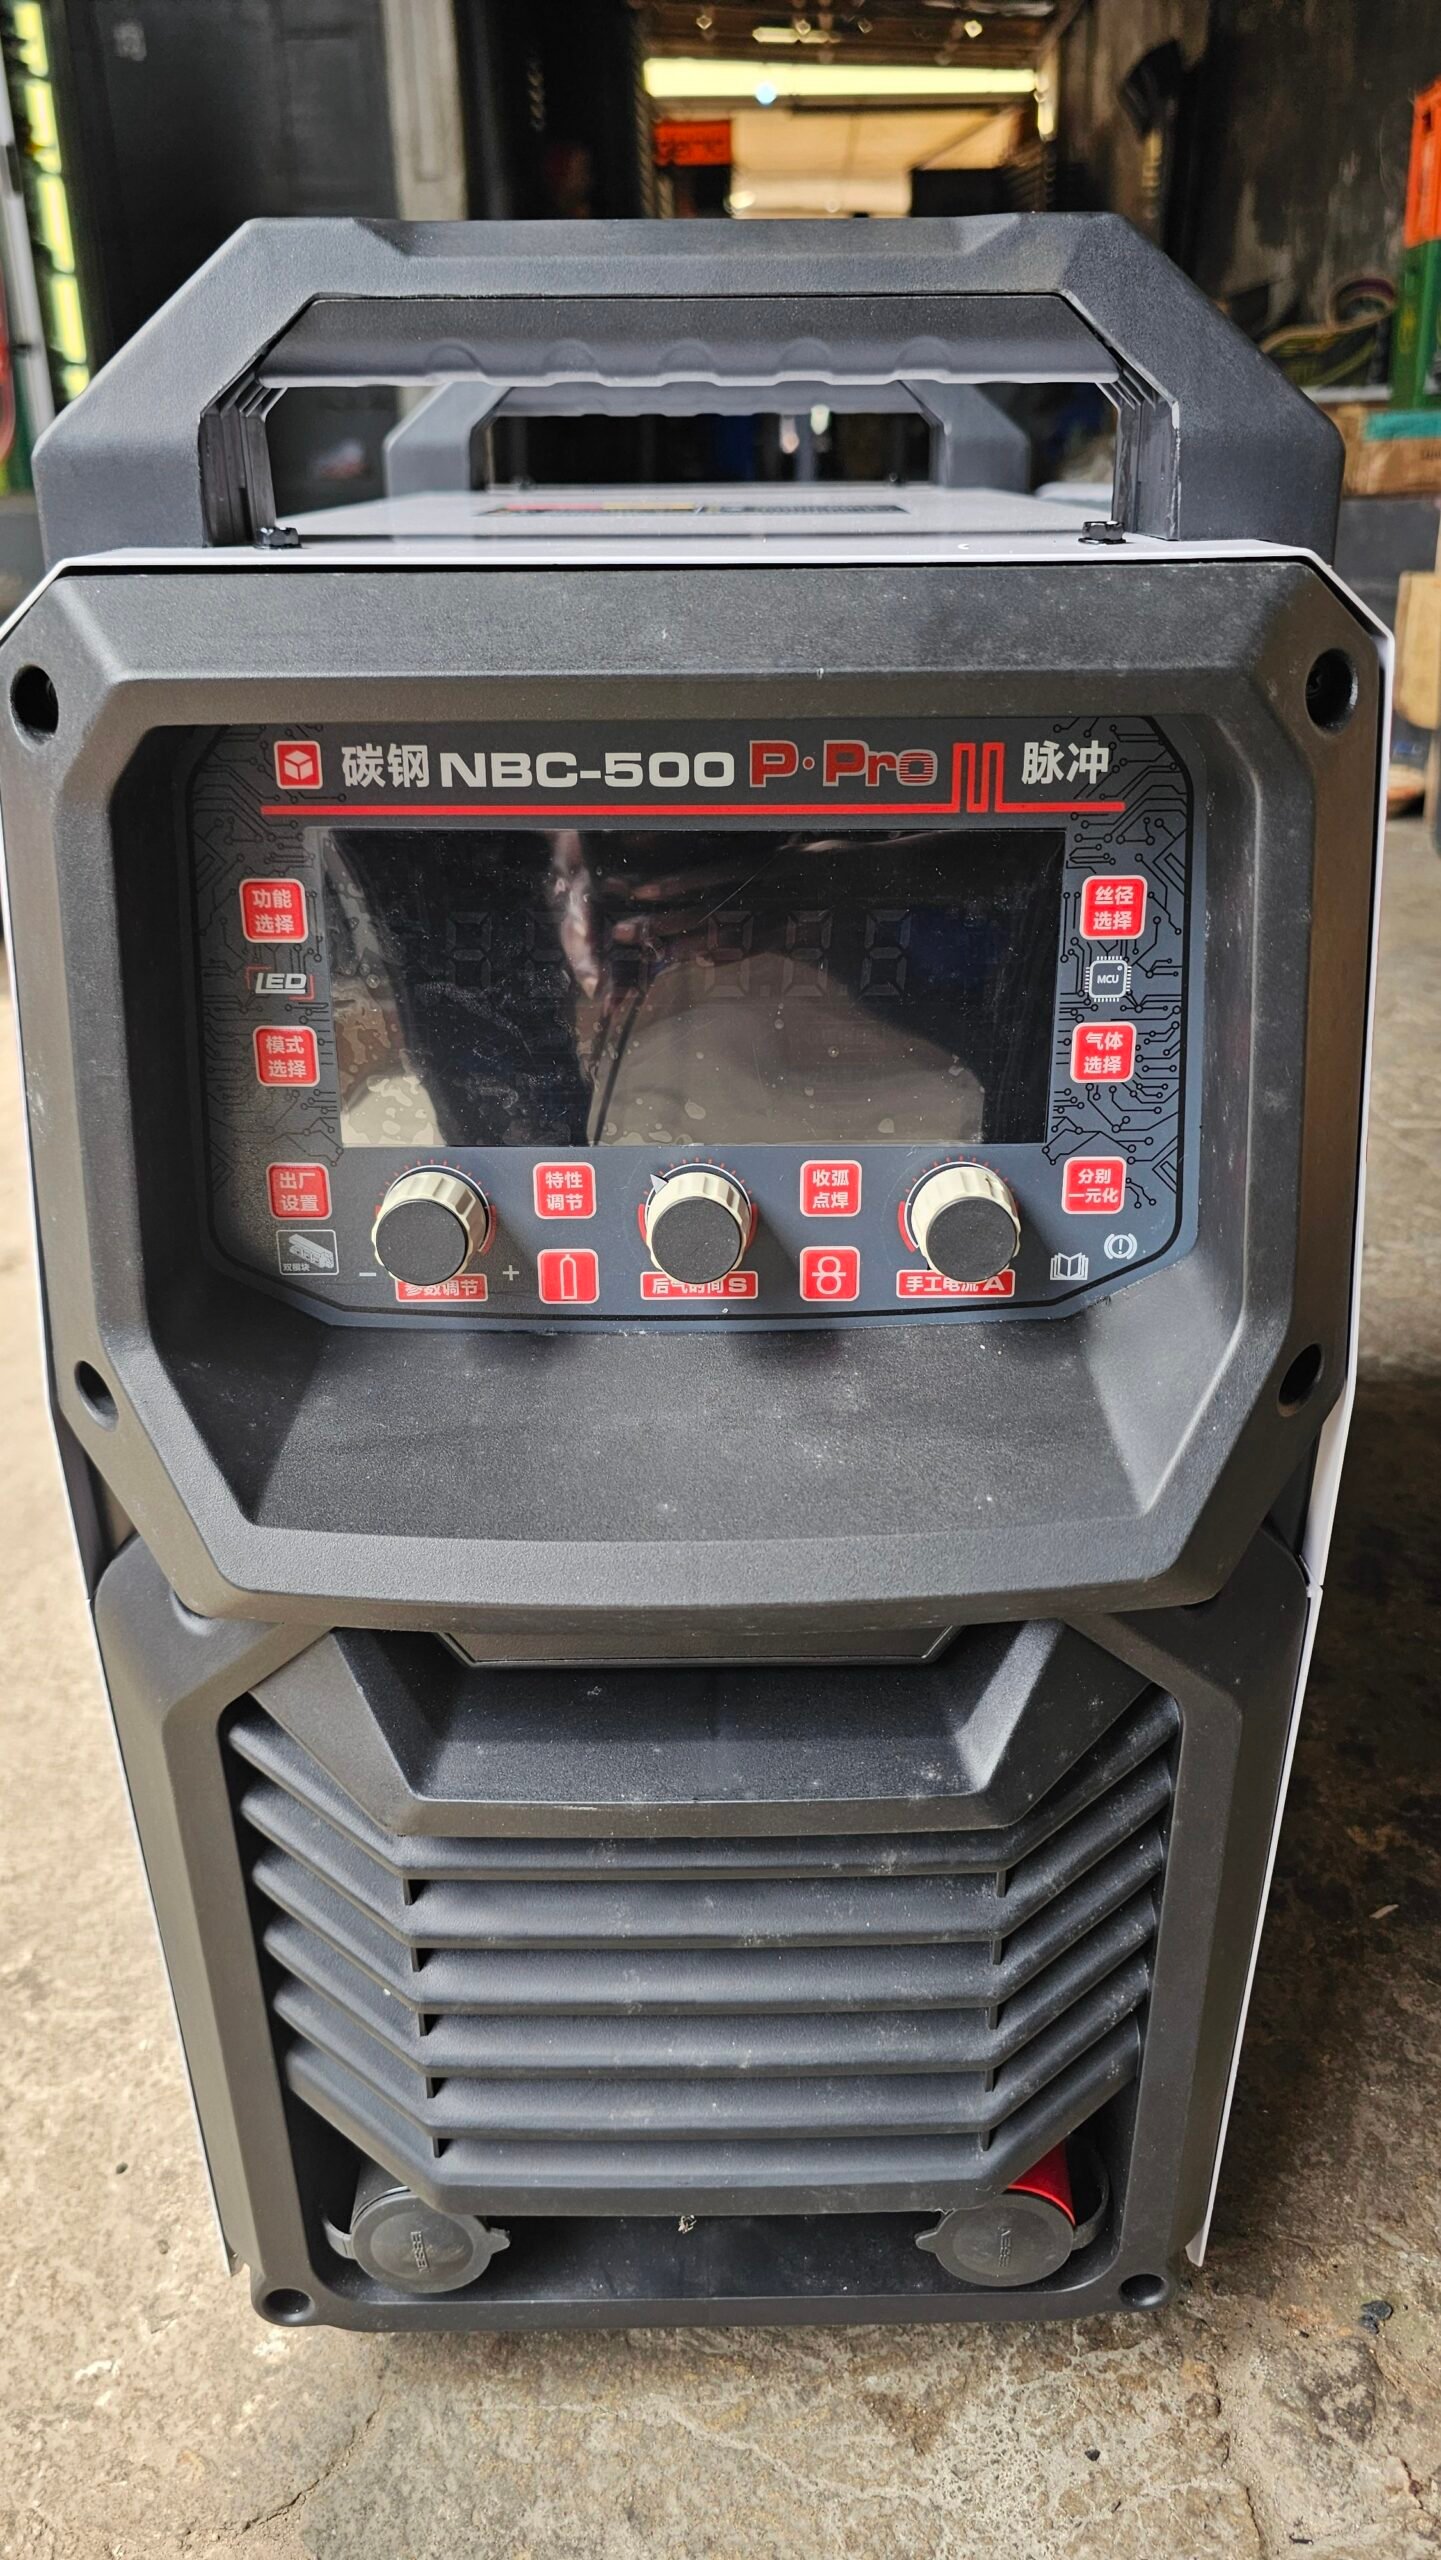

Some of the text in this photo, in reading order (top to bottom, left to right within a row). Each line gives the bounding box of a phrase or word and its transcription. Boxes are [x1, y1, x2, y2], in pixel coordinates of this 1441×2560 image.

[341, 743, 429, 788] 碳钢
[440, 752, 734, 788] NBC-500
[1021, 740, 1110, 785] 脉冲
[252, 889, 293, 909] 功能
[1094, 886, 1134, 905] 丝径
[255, 914, 295, 934] 选择
[1092, 911, 1133, 930] 选择
[255, 972, 307, 995] LED
[1096, 974, 1120, 985] MCU
[265, 1035, 305, 1054] 模式
[1085, 1031, 1124, 1050] 气体
[268, 1059, 308, 1079] 选择
[1083, 1055, 1122, 1075] 选择
[279, 1171, 316, 1190] 出厂
[545, 1171, 584, 1189] 特性
[812, 1169, 850, 1187] 收弧
[1077, 1168, 1112, 1185] 分别
[280, 1194, 320, 1212] 设置
[546, 1193, 583, 1211] 调节
[812, 1191, 849, 1209] 点焊
[1067, 1187, 1119, 1204] 一元化
[728, 1277, 748, 1293] S
[983, 1276, 1005, 1291] A
